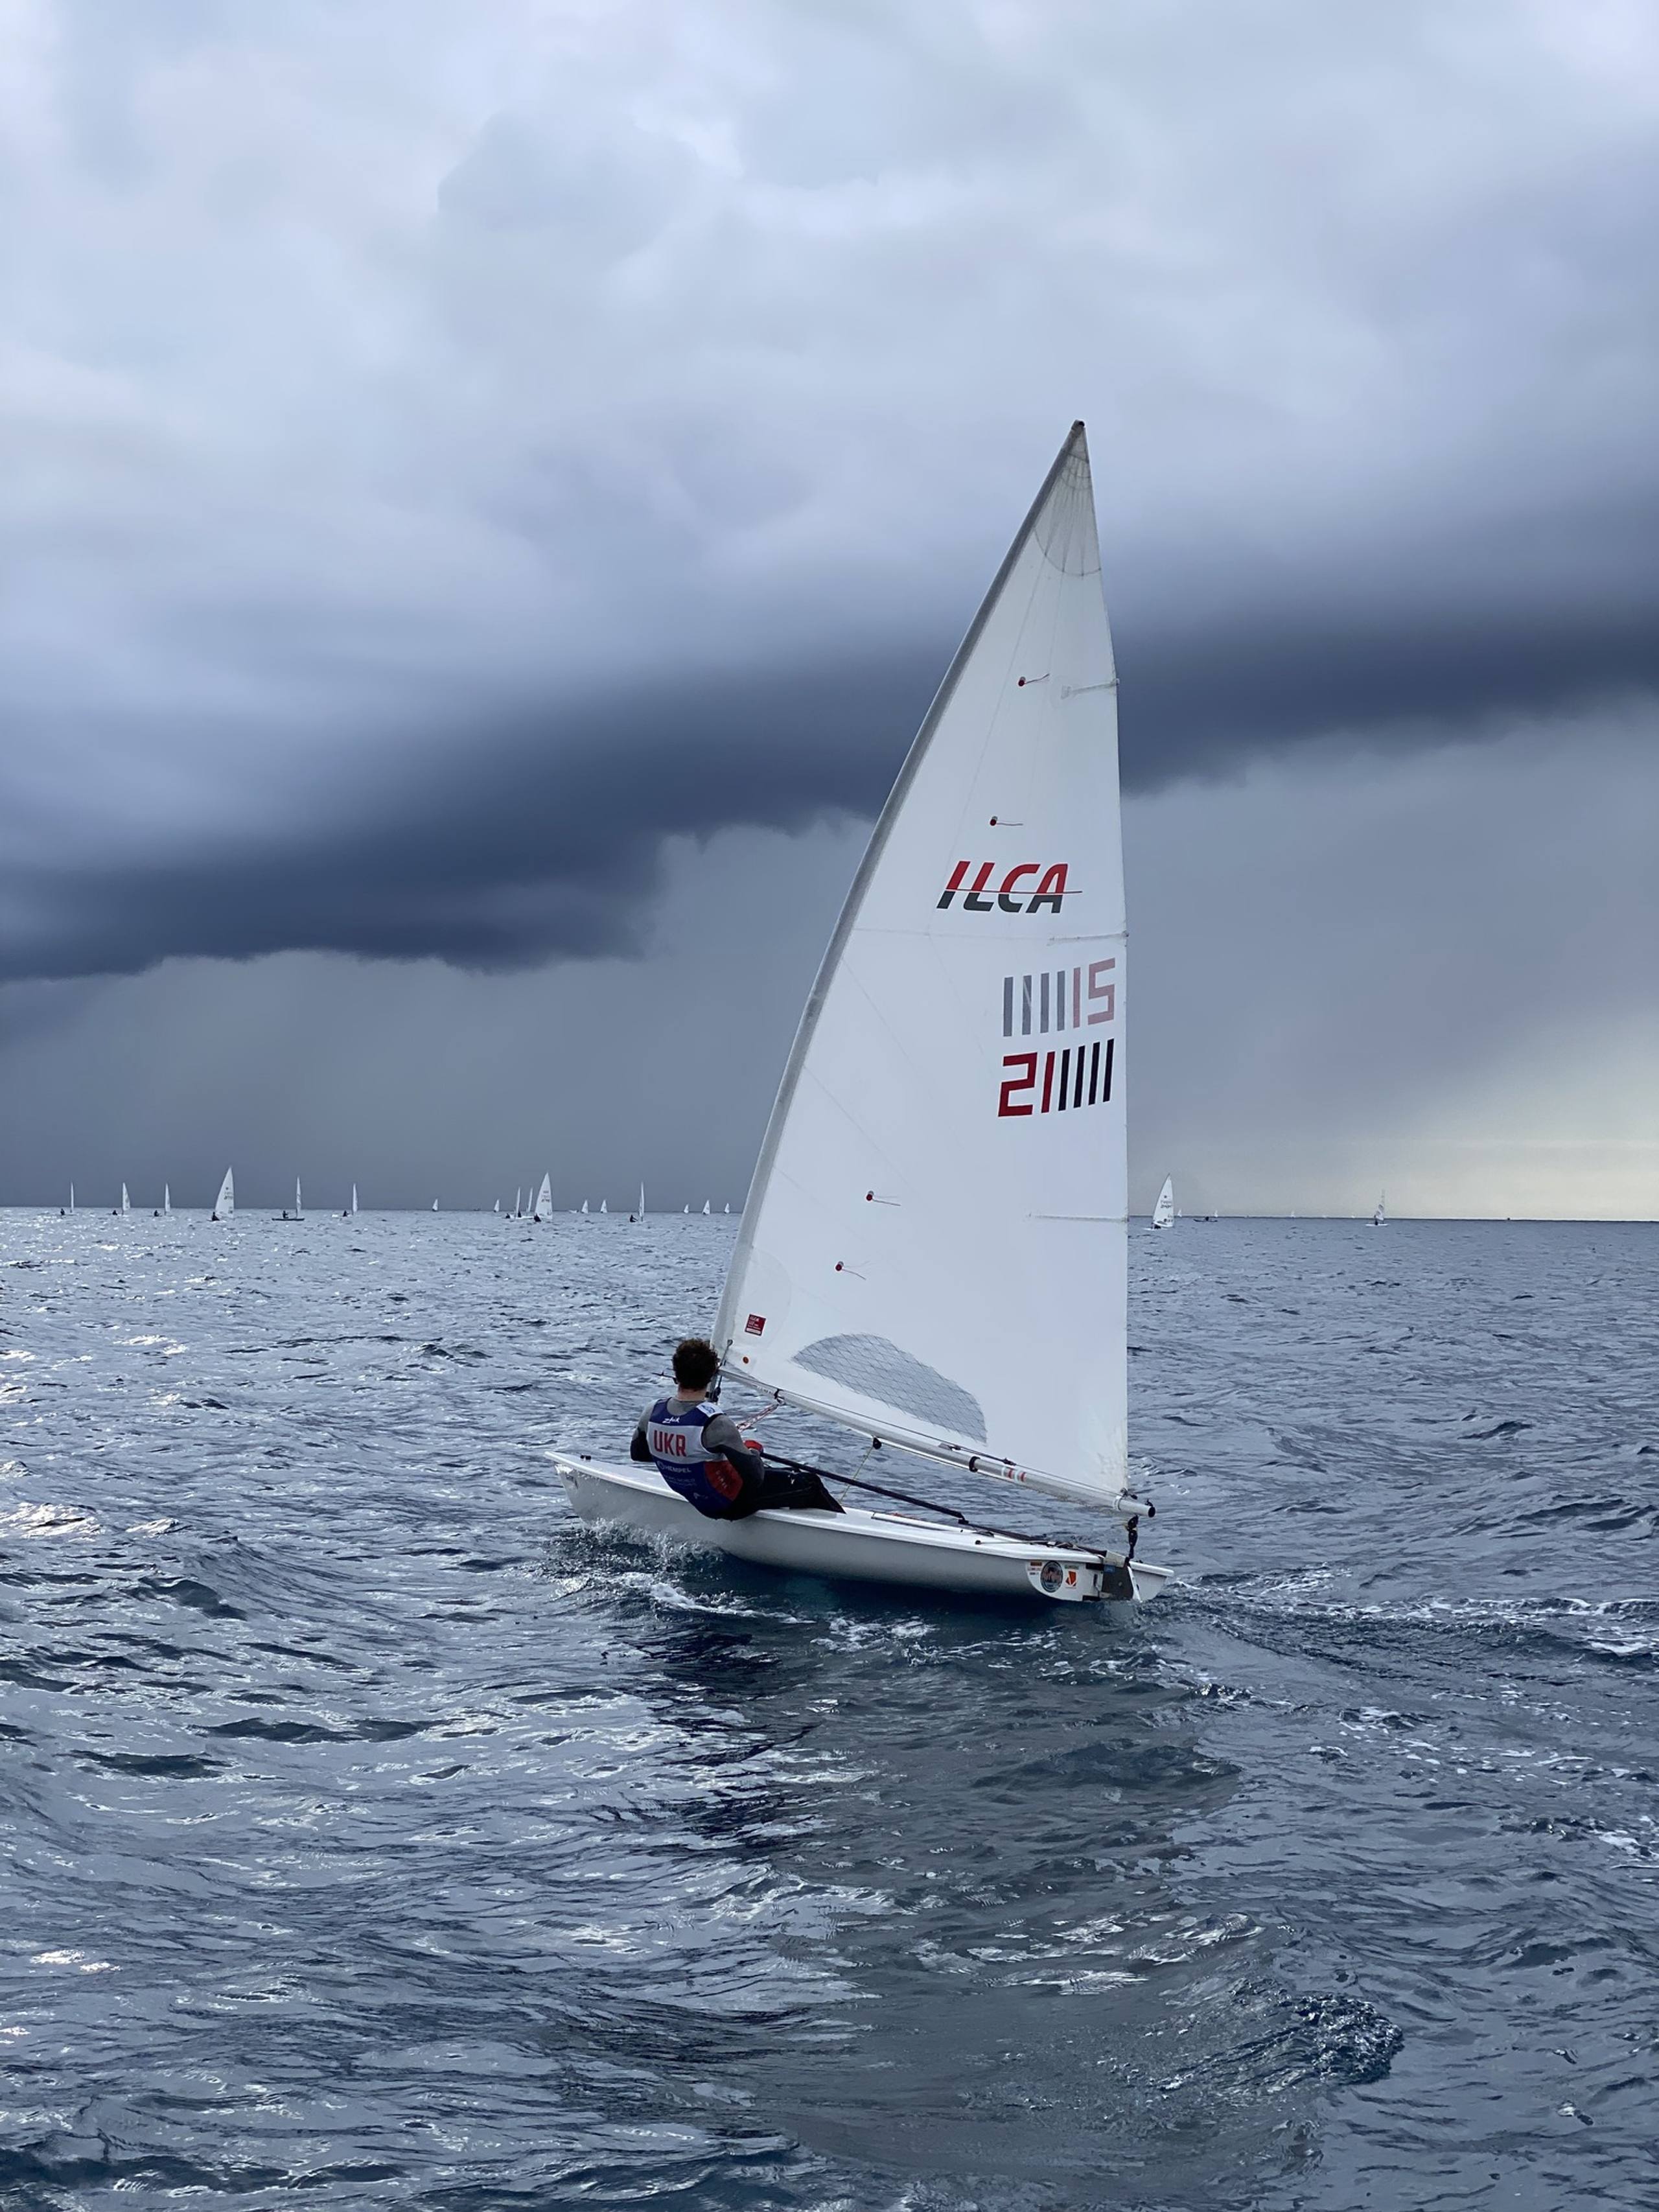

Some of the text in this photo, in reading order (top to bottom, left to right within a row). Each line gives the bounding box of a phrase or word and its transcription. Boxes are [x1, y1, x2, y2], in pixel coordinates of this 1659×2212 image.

[936, 861, 1069, 914] ILCA
[998, 1038, 1114, 1117] 211111
[654, 1430, 687, 1457] UKR
